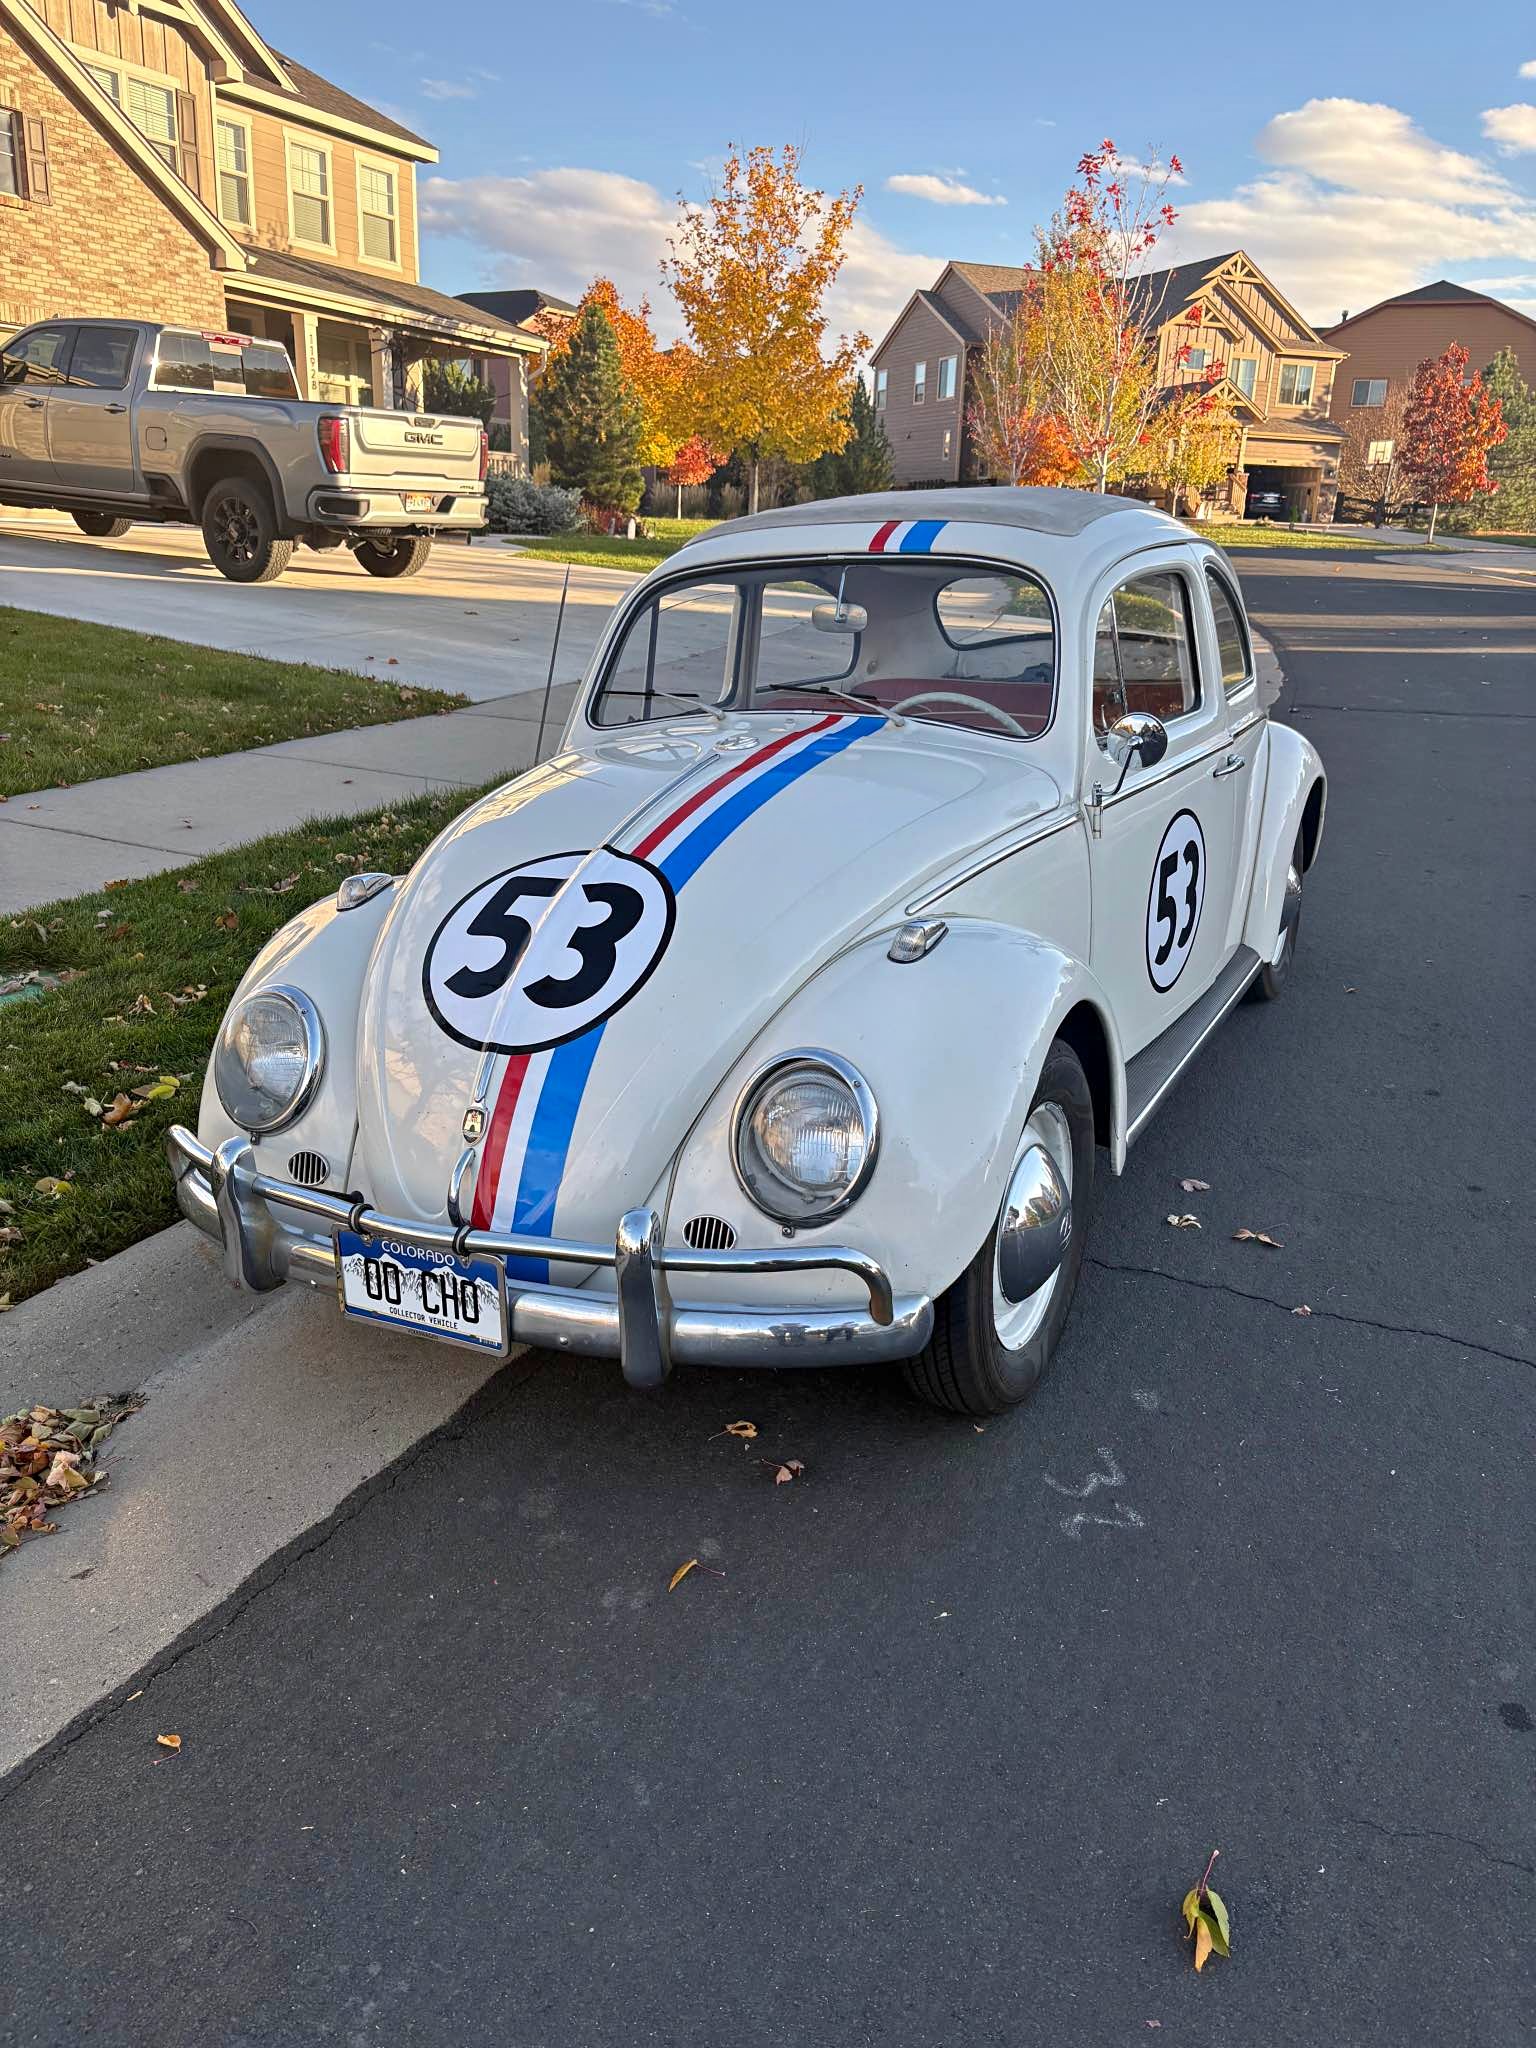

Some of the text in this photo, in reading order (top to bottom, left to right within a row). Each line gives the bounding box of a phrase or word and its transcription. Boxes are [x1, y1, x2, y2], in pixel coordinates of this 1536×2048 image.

[404, 431, 443, 445] GMC
[1155, 840, 1199, 966] 53
[444, 876, 645, 1009] 53
[381, 1240, 455, 1267] COLORADO
[389, 1306, 458, 1330] COLLECTOR VEHICLE
